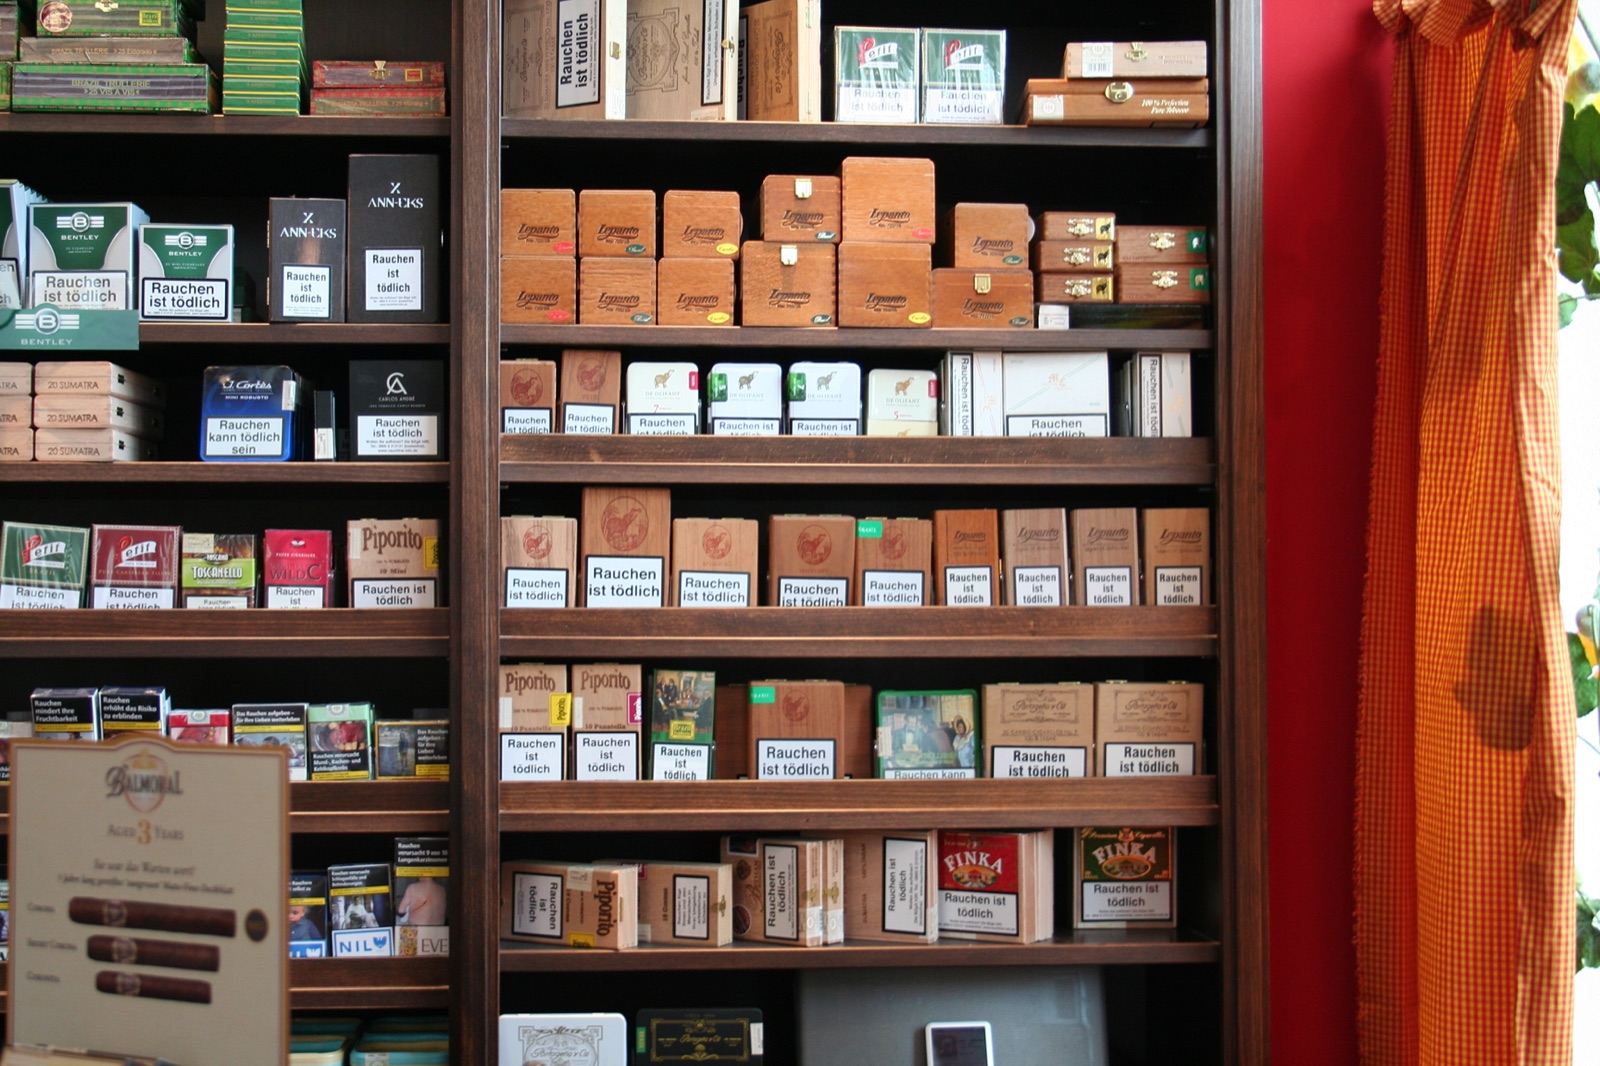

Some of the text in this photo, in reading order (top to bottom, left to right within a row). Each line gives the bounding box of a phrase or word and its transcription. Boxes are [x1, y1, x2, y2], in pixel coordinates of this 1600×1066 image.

[576, 13, 588, 64] tödlich
[560, 20, 573, 85] Rauchen
[71, 79, 151, 88] BRAZIL TRULLERIE
[782, 210, 824, 227] Lepanto
[870, 208, 910, 225] Lepanto
[517, 223, 560, 240] Lepanto
[597, 223, 640, 241] Lepanto
[682, 225, 725, 242] Lepanto
[972, 236, 1014, 253] Lepanto
[372, 254, 414, 264] Rauchen
[46, 276, 111, 288] Rauchen
[286, 272, 326, 282] Rauchen
[152, 282, 214, 294] Rauchen
[376, 282, 410, 292] tödlich
[44, 290, 117, 302] ist tödlich
[150, 296, 220, 308] ist tödlich
[290, 294, 322, 304] tödlich
[516, 291, 560, 308] Lepanto
[598, 292, 640, 309] Lepanto
[676, 293, 719, 309] Lepanto
[769, 289, 810, 306] Lepanto
[866, 293, 907, 310] Lepanto
[962, 299, 1004, 316] Lepanto
[20, 338, 73, 346] BENTLEY
[962, 357, 970, 400] Rauchen
[1150, 358, 1158, 402] Rauchen
[59, 382, 99, 390] SUMATRA
[47, 414, 98, 422] 20 SUMATRA
[376, 418, 420, 427] Rauchen
[508, 416, 546, 424] Rauchen
[568, 414, 608, 422] Rauchen
[640, 418, 686, 427] Rauchen
[1031, 419, 1082, 429] Rauchen
[220, 420, 270, 430] Rauchen
[719, 422, 760, 431] Rauchen
[797, 422, 838, 432] Rauchen
[208, 432, 280, 442] kann tödlich
[388, 428, 422, 438] tödlich
[48, 448, 100, 456] 20 SUMATRA
[232, 444, 256, 454] sein
[362, 524, 422, 554] Piporito
[1016, 527, 1059, 543] Lepanto
[1087, 527, 1130, 544] Lepanto
[1159, 528, 1202, 544] Lepanto
[192, 566, 243, 579] TOSCANELLO
[593, 568, 657, 580] Rauchen
[949, 573, 988, 582] Rauchen
[1018, 573, 1056, 582] Rauchen
[1089, 573, 1127, 582] Rauchen
[1159, 574, 1198, 582] Rauchen
[362, 584, 427, 594] Rauchen ist
[512, 578, 561, 589] Rauchen
[685, 578, 740, 590] Rauchen
[784, 584, 839, 595] Rauchen
[870, 580, 917, 591] Rauchen
[16, 588, 65, 600] Rauchen
[110, 588, 158, 600] Rauchen
[276, 587, 316, 596] Rauchen
[510, 590, 564, 601] ist tödlich
[588, 584, 660, 597] ist tödlich
[376, 596, 413, 605] tödlich
[682, 591, 745, 603] ist tödlich
[867, 594, 920, 604] ist tödlich
[505, 670, 556, 696] Piporito
[580, 670, 631, 694] Piporito
[34, 700, 62, 708] Rauchen
[103, 696, 130, 704] Rauchen
[35, 708, 60, 716] mindert
[103, 704, 158, 712] erhöht das Risiko
[556, 698, 566, 721] Piporito
[36, 714, 78, 722] Fruchtbarkeit
[112, 712, 142, 720] erblinden
[508, 739, 556, 748] Rauchen
[582, 738, 631, 748] Rauchen
[525, 752, 539, 761] ist
[600, 751, 613, 760] ist
[660, 746, 702, 757] Rauchen
[766, 746, 826, 759] Rauchen
[1013, 750, 1066, 762] Rauchen
[1124, 746, 1176, 758] Rauchen
[512, 764, 550, 774] tödlich
[588, 763, 625, 772] tödlich
[782, 764, 830, 776] tödlich
[1138, 761, 1180, 773] tödlich
[138, 818, 152, 844] 3
[1092, 842, 1157, 865] FINKA
[944, 851, 1003, 875] FINKA
[778, 871, 786, 913] tödlich
[888, 872, 896, 912] Rauchen
[1094, 883, 1159, 894] Rauchen ist
[528, 886, 538, 923] tödlich
[768, 875, 776, 928] Rauchen
[944, 892, 1006, 906] Rauchen ist
[1107, 896, 1145, 907] tödlich
[550, 882, 558, 930] Rauchen
[593, 880, 618, 937] Piporito
[957, 906, 994, 919] tödlich
[340, 940, 373, 953] NIL
[422, 938, 448, 952] EVE
